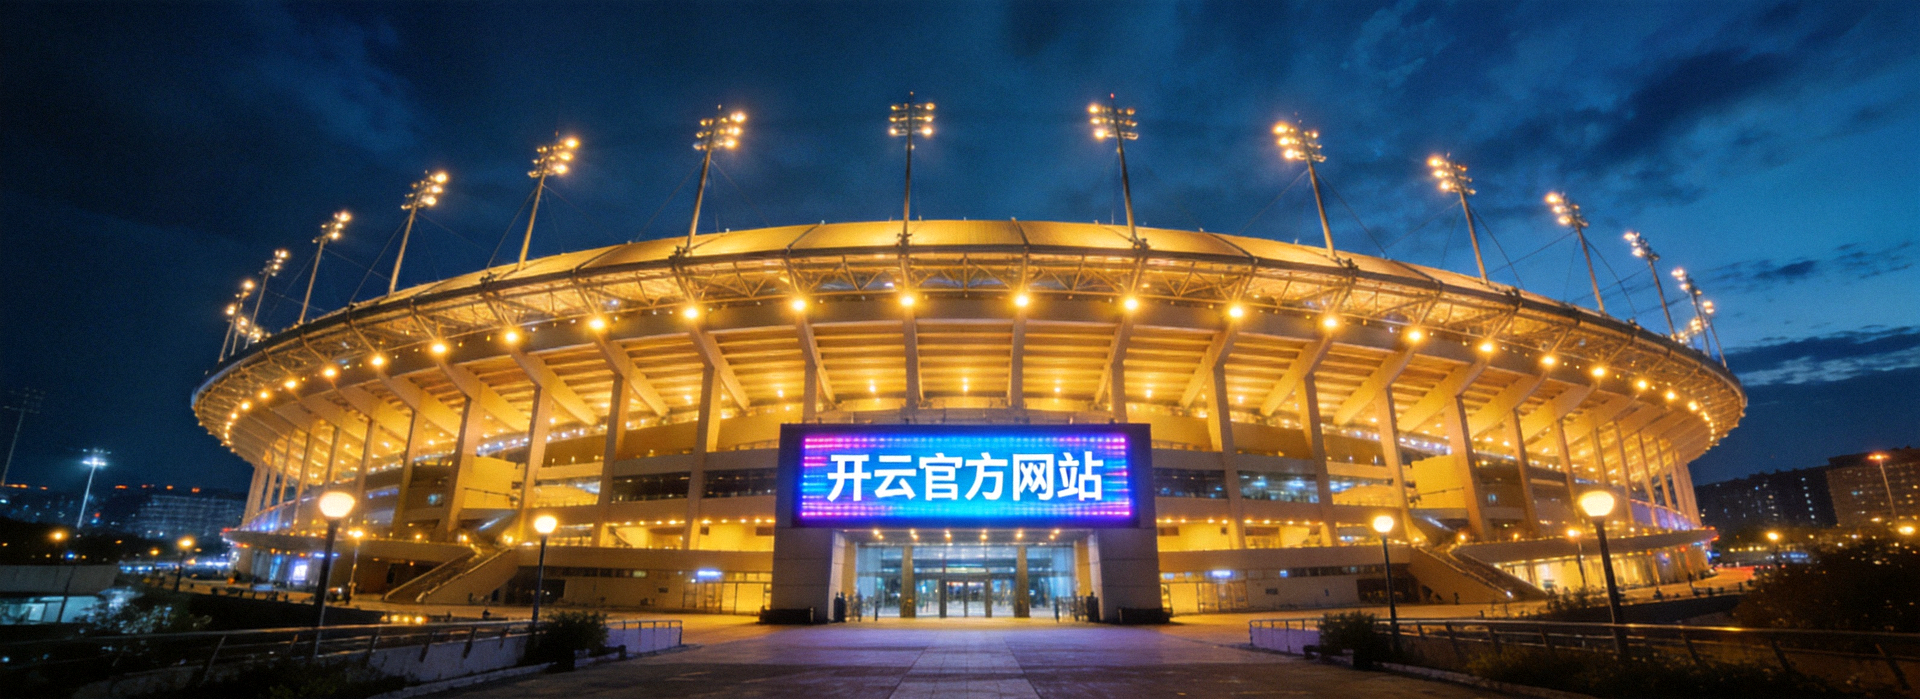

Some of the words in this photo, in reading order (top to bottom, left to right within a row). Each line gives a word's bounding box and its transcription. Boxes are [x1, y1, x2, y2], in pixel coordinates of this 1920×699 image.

[827, 451, 1104, 502] 开云官方网站
